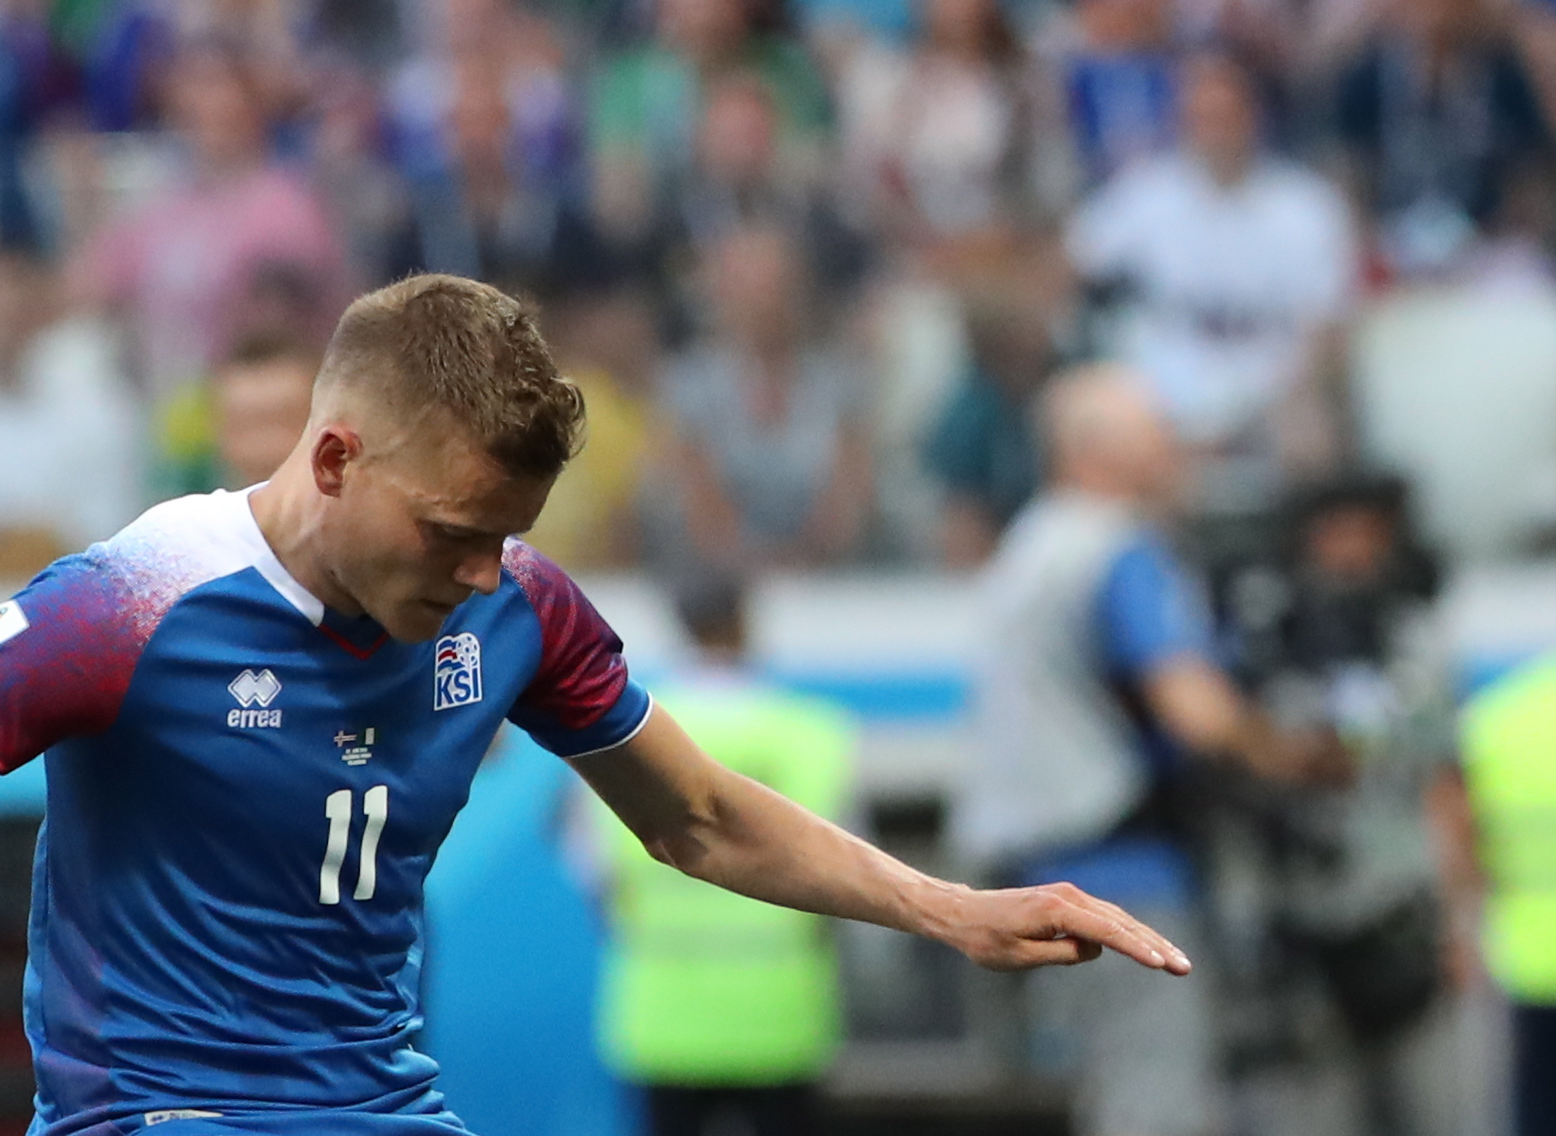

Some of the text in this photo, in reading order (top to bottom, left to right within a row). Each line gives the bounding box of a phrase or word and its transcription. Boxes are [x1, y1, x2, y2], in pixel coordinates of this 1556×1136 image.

[436, 668, 480, 707] KSI
[227, 709, 282, 728] errea
[319, 785, 388, 904] 11
